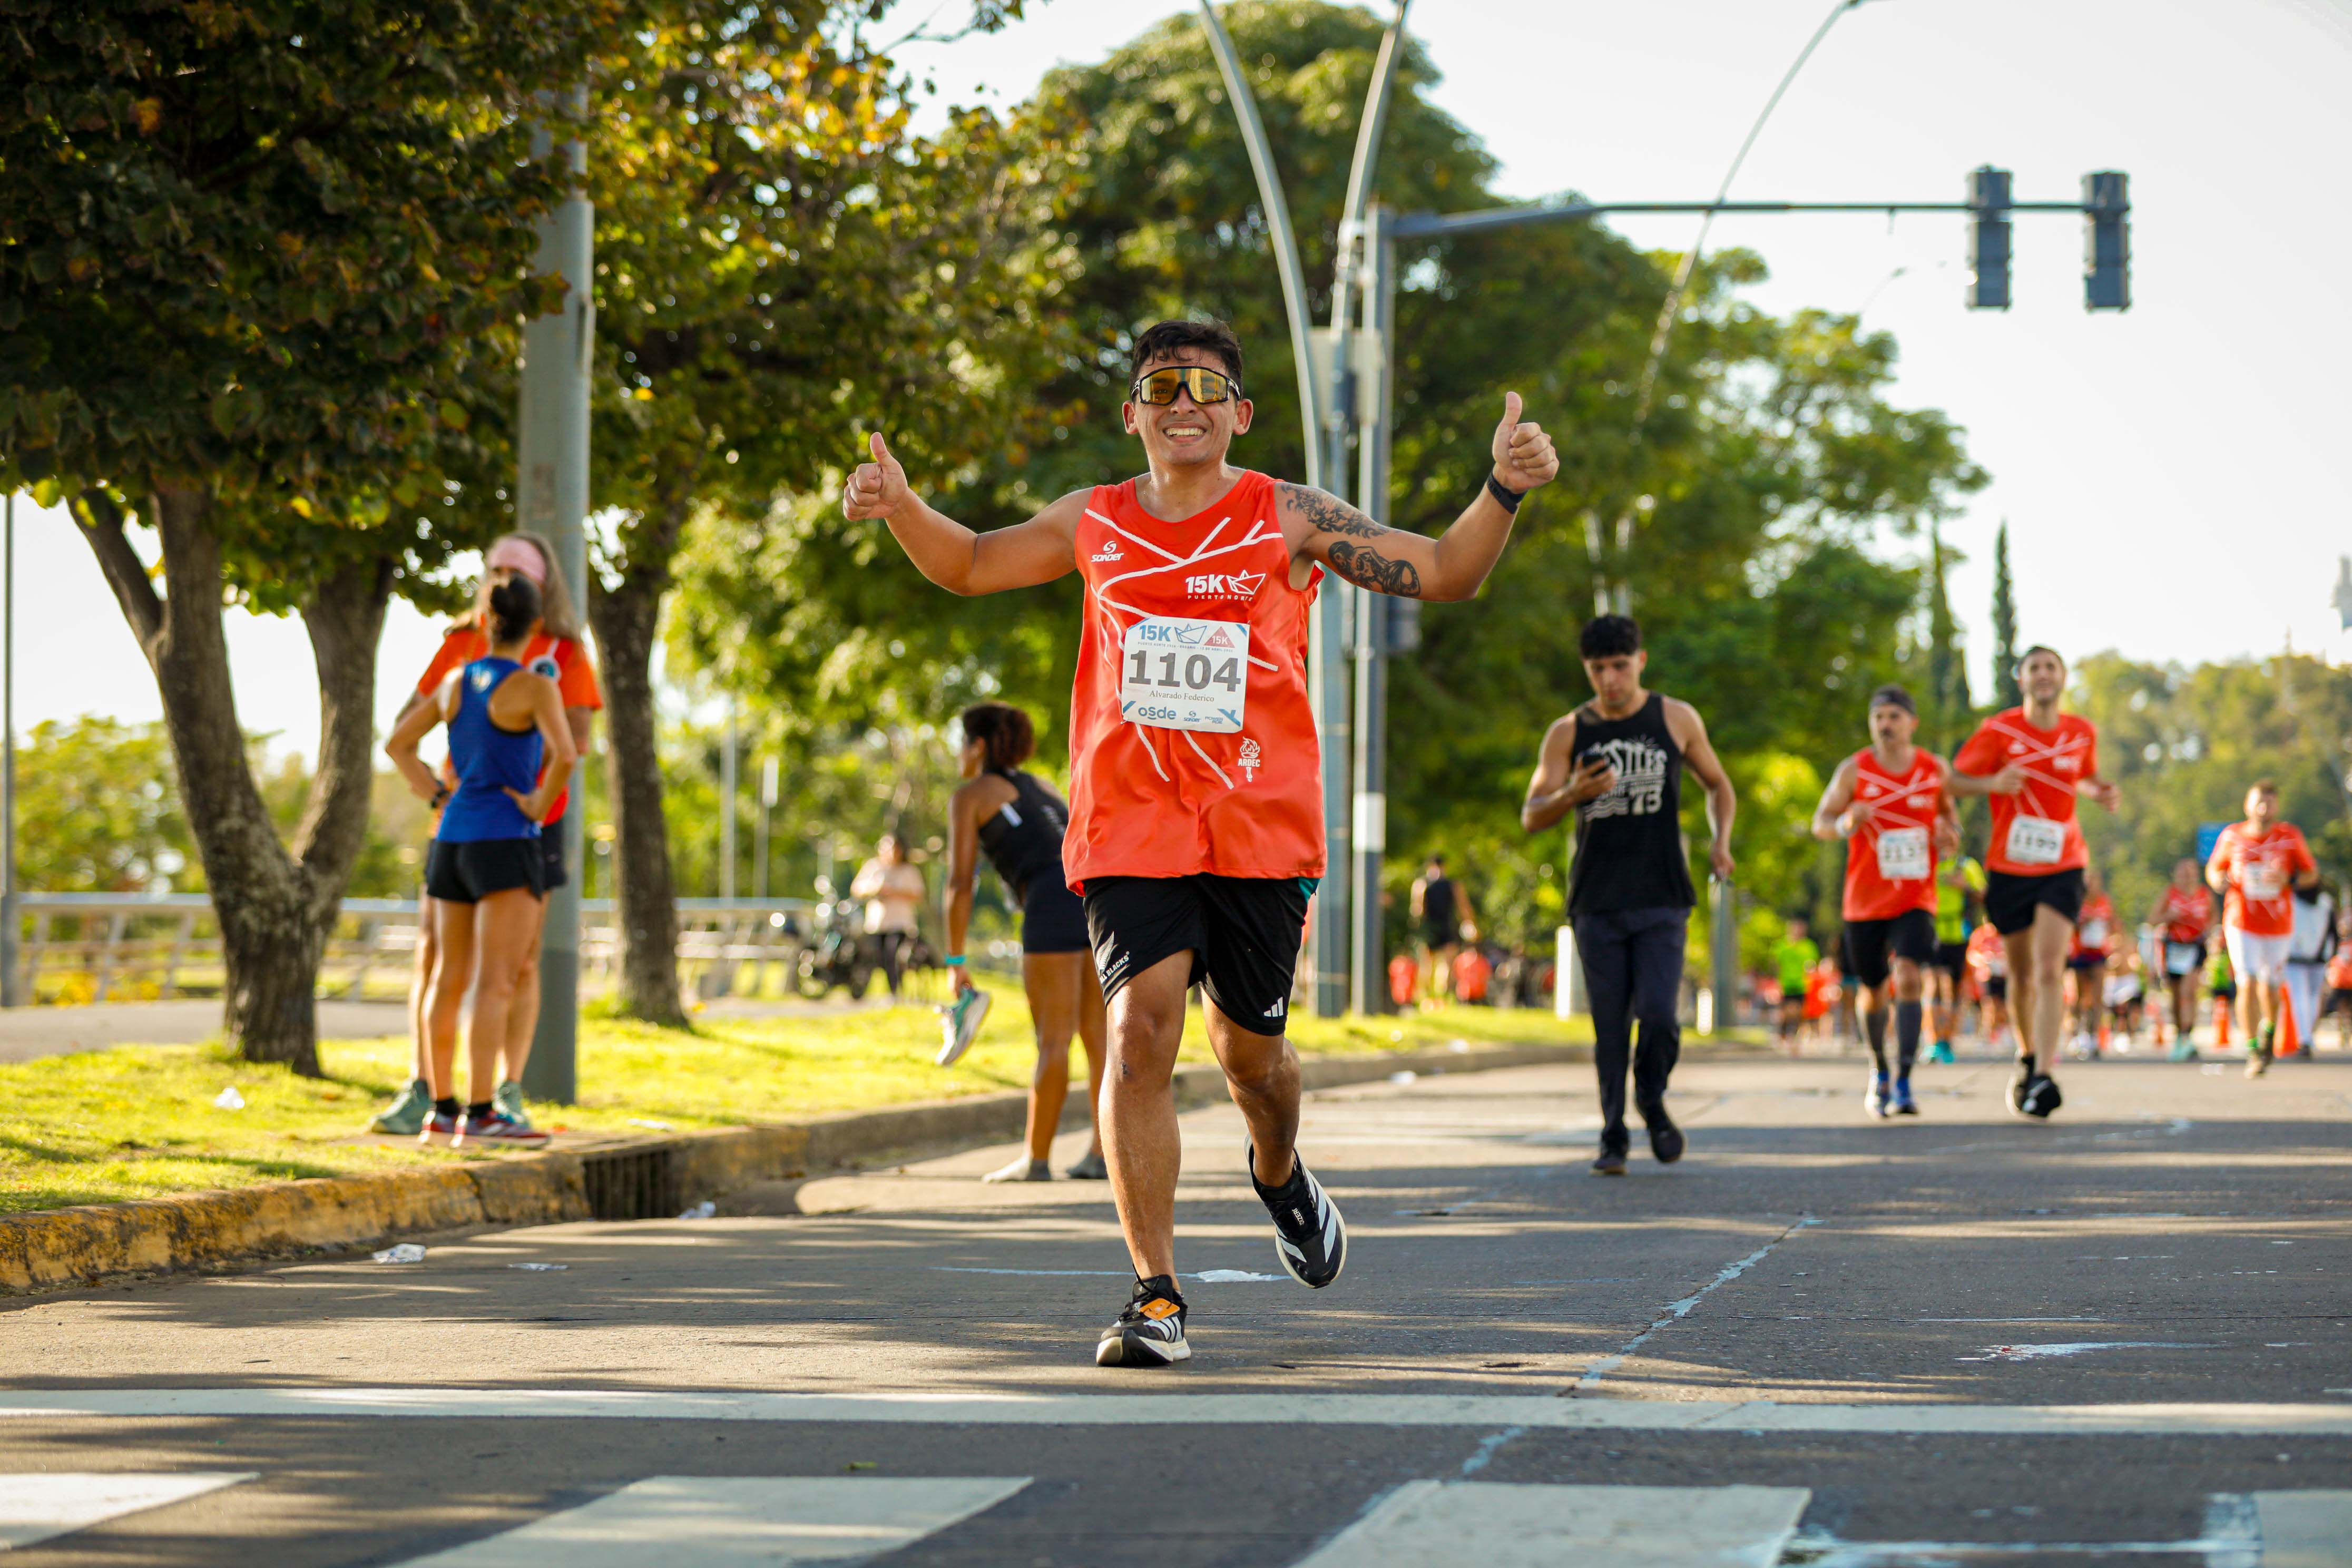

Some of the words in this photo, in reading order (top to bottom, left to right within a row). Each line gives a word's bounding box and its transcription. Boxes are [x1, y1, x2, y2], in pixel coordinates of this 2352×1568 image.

[1185, 574, 1225, 593] 15K
[1139, 625, 1172, 642] 15K
[1212, 636, 1228, 645] 15K
[1129, 650, 1241, 692] 1104
[1149, 690, 1182, 700] Alvarado
[1184, 693, 1214, 702] Federico
[1138, 706, 1177, 720] osde
[1238, 758, 1261, 767] ARDEC
[1106, 955, 1129, 977] BLACKS
